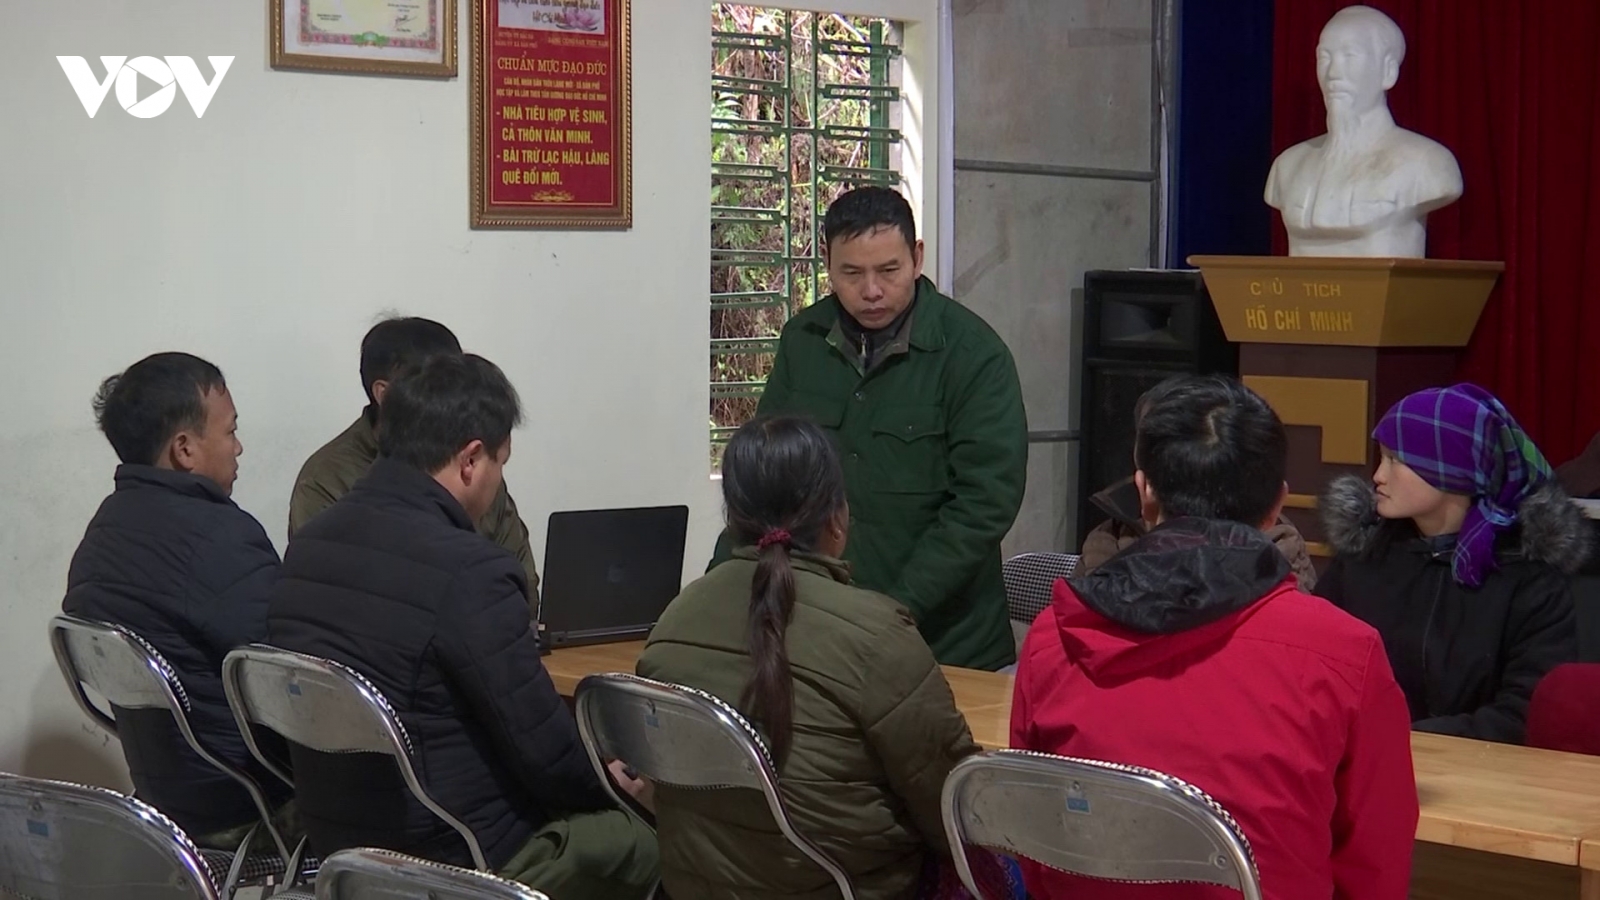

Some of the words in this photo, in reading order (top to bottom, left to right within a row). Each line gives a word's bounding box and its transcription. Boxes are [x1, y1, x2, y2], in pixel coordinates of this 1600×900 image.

[497, 51, 535, 71] CHUẨN
[538, 59, 559, 75] MỰC
[562, 61, 584, 77] ĐẠO
[587, 60, 607, 76] ĐỨC
[503, 104, 523, 120] NHÀ
[525, 105, 545, 121] TIÊU
[547, 108, 566, 125] HỢP
[569, 107, 580, 126] VỆ
[582, 109, 607, 125] SINH,
[502, 122, 515, 141] CẢ
[517, 126, 542, 142] THÔN
[544, 126, 563, 143] VĂN
[566, 130, 593, 144] MINH.
[503, 147, 519, 163] BÀI
[521, 147, 541, 164] TRỪ
[541, 150, 559, 166] LẠC
[562, 148, 584, 167] HẬU,
[586, 149, 609, 165] LÀNG
[502, 168, 521, 185] QUÊ
[523, 166, 539, 185] ĐỔI
[541, 168, 563, 186] MỚI.
[1274, 306, 1301, 331] CHÍ
[1309, 310, 1354, 332] MINH
